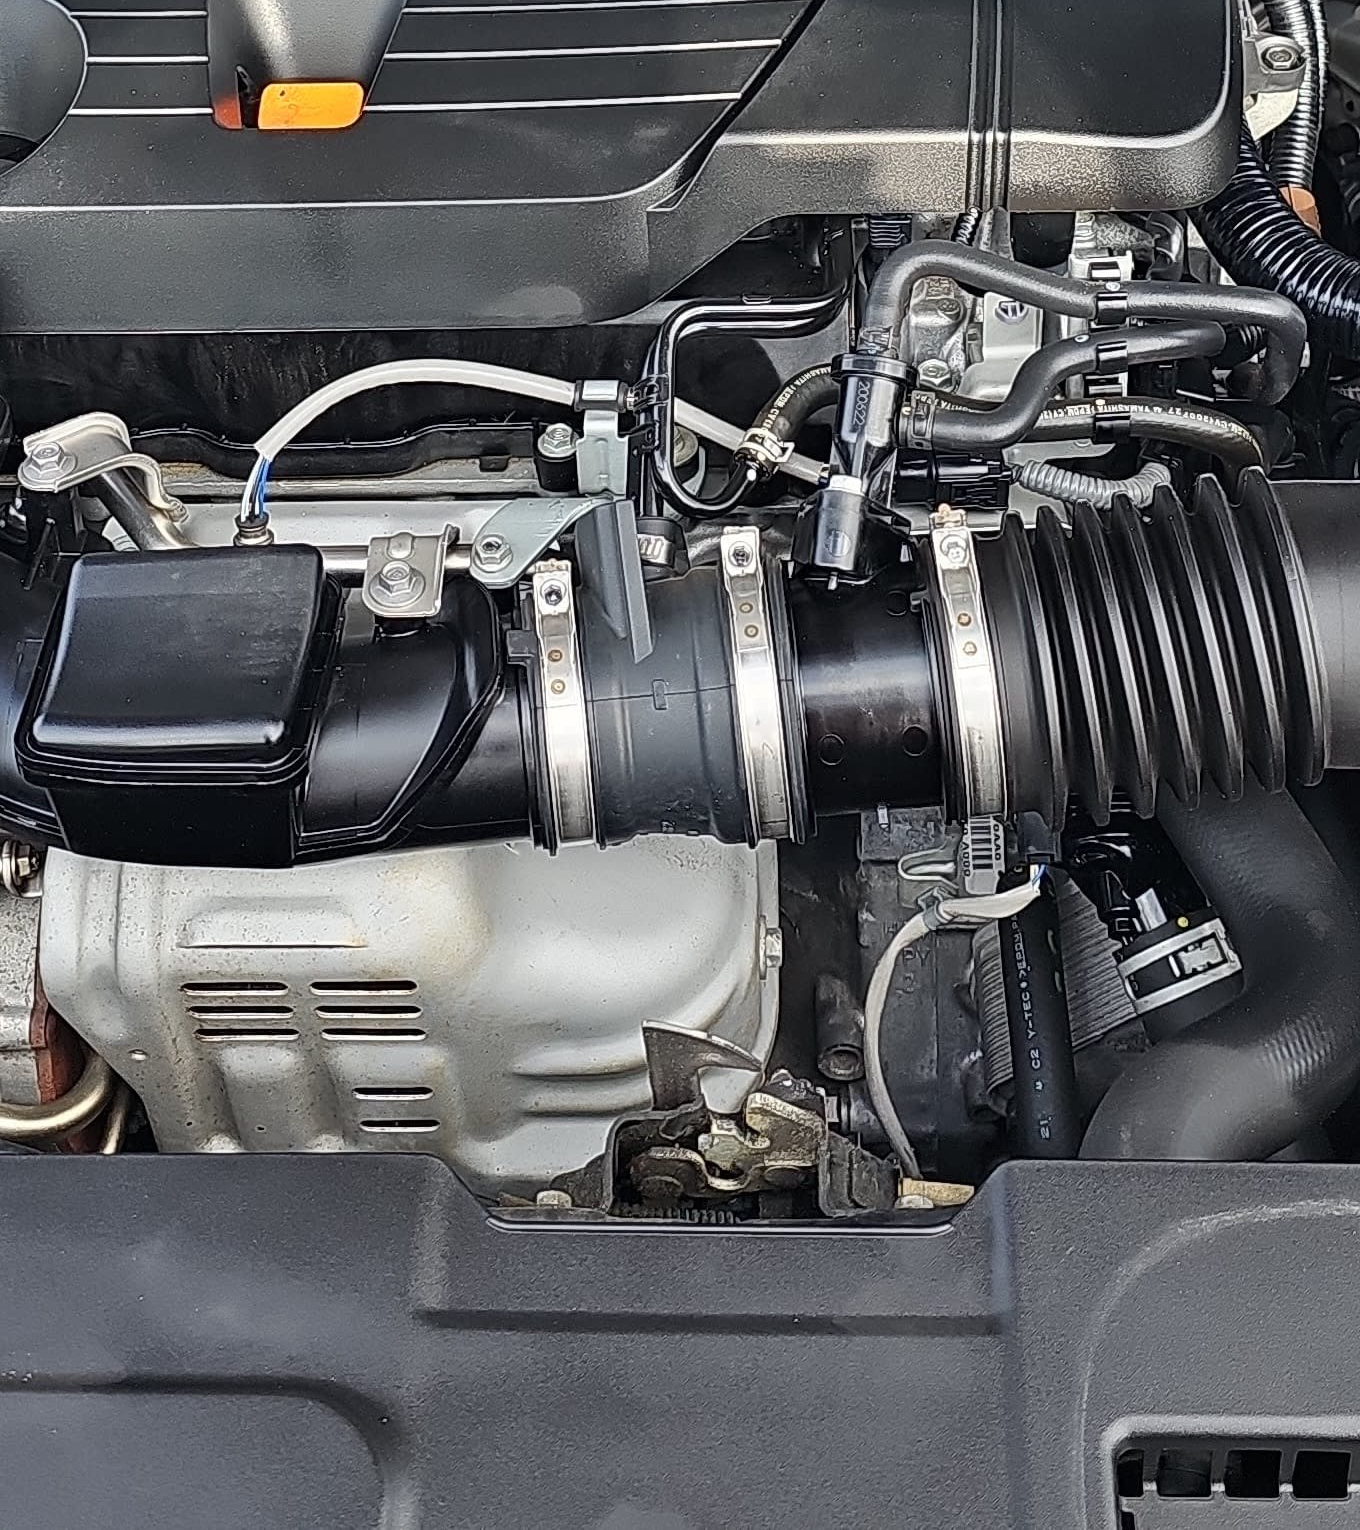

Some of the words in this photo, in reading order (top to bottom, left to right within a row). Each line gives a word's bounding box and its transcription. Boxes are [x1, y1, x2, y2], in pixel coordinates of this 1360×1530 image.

[852, 380, 871, 426] 200622
[1020, 990, 1038, 1040] Y-TEC
[1029, 1047, 1042, 1070] C2
